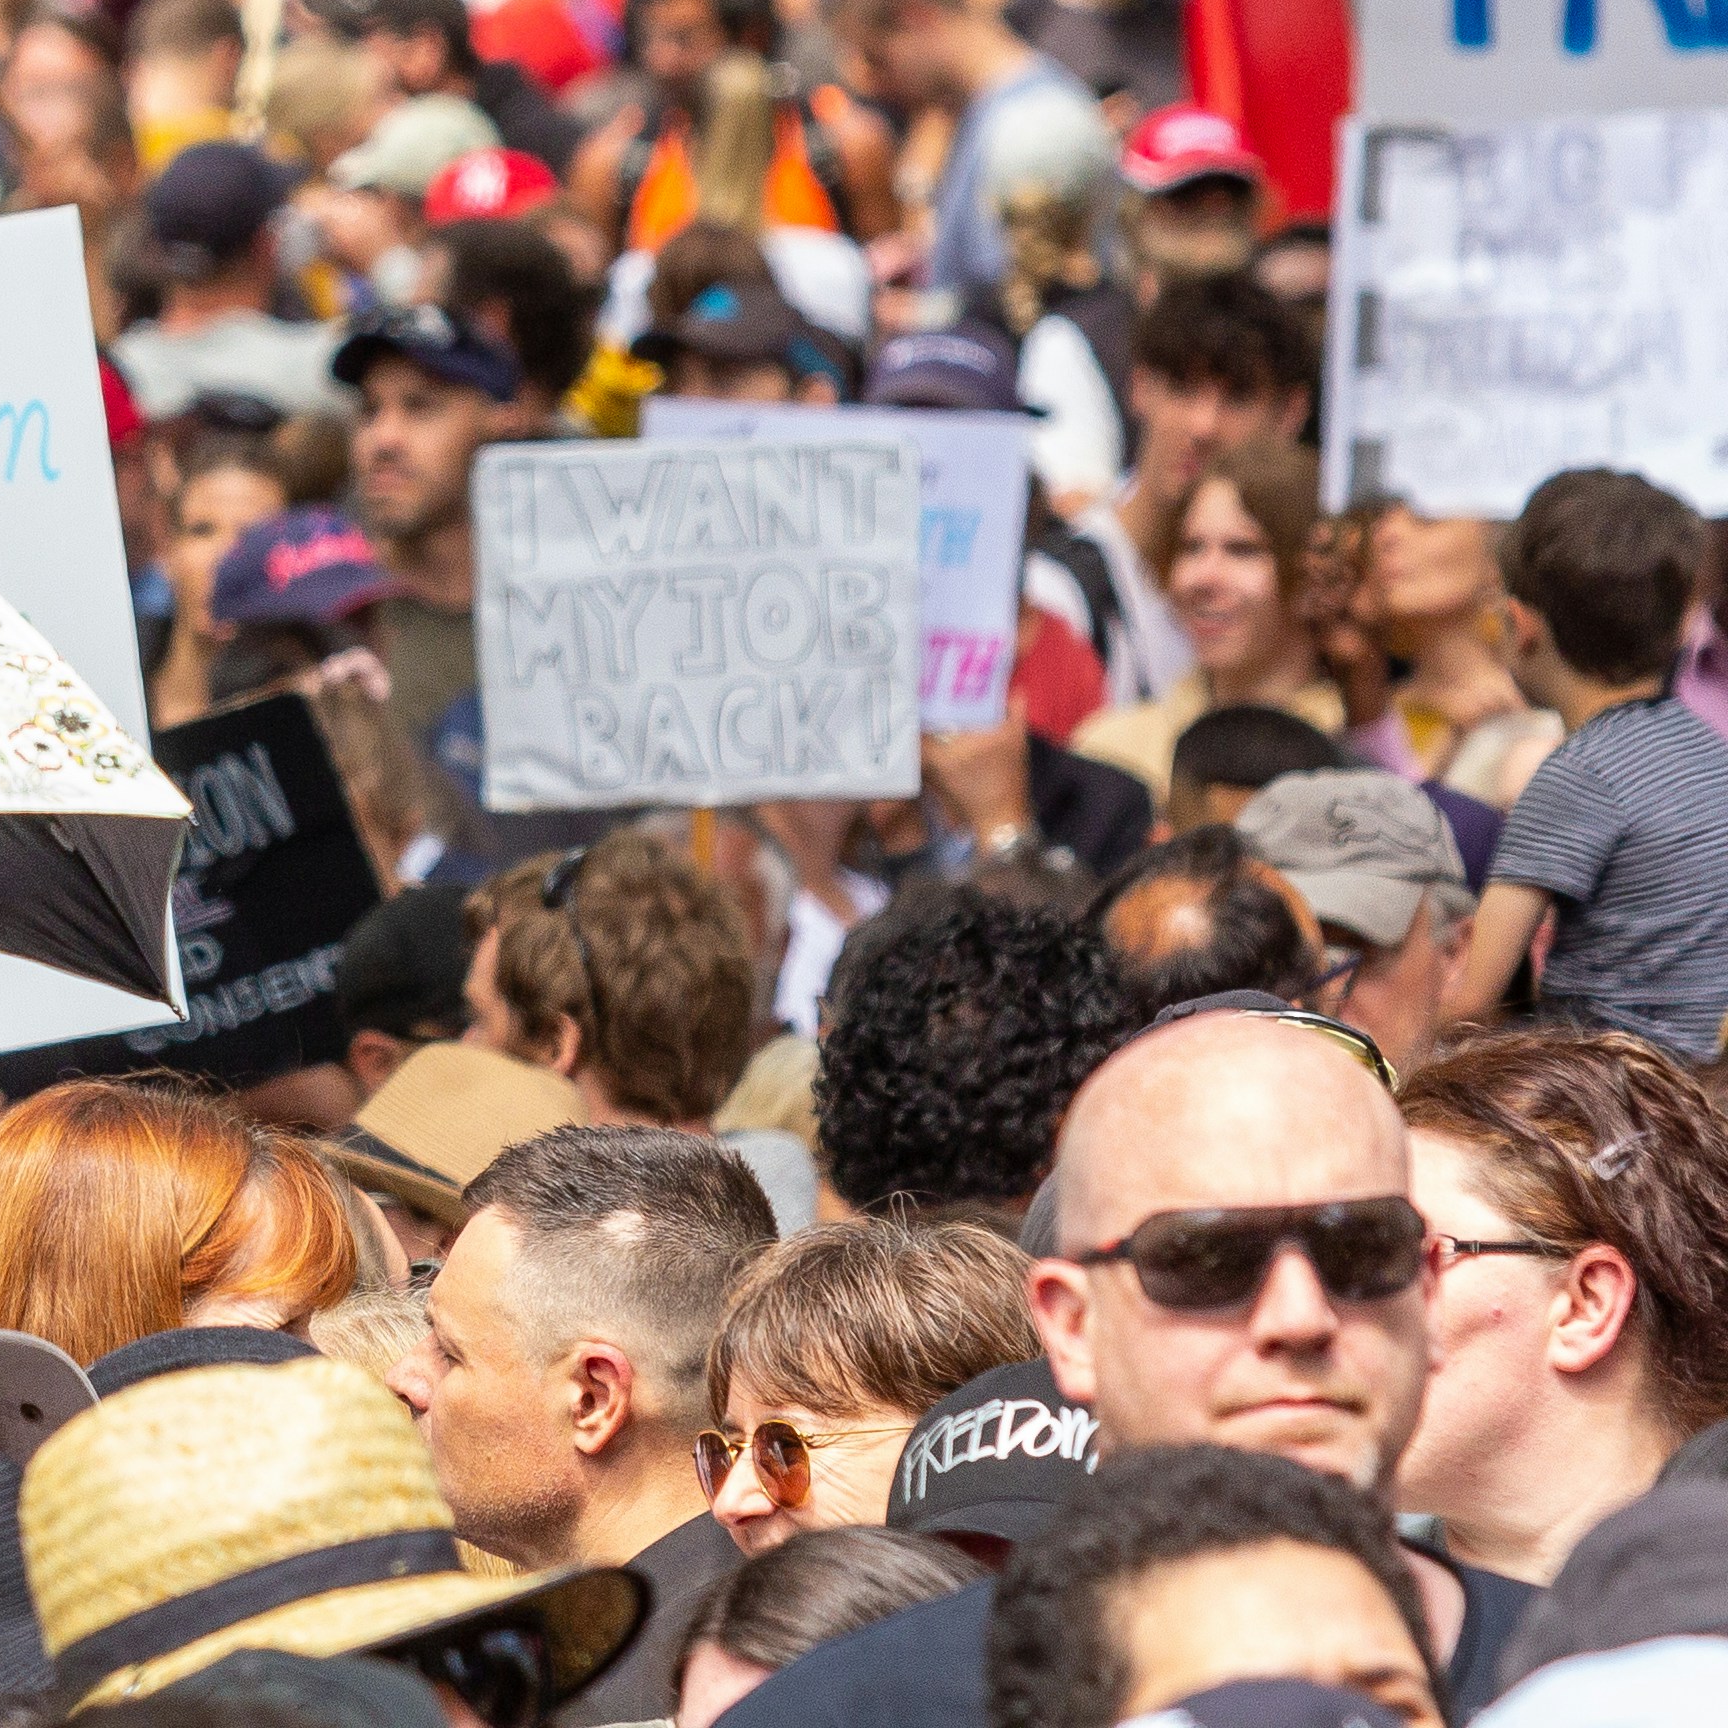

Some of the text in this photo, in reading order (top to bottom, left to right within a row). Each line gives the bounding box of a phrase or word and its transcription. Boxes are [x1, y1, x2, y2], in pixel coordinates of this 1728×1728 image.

[560, 447, 902, 560] WANT
[499, 559, 896, 685] MY JOB
[569, 672, 894, 789] BACK!
